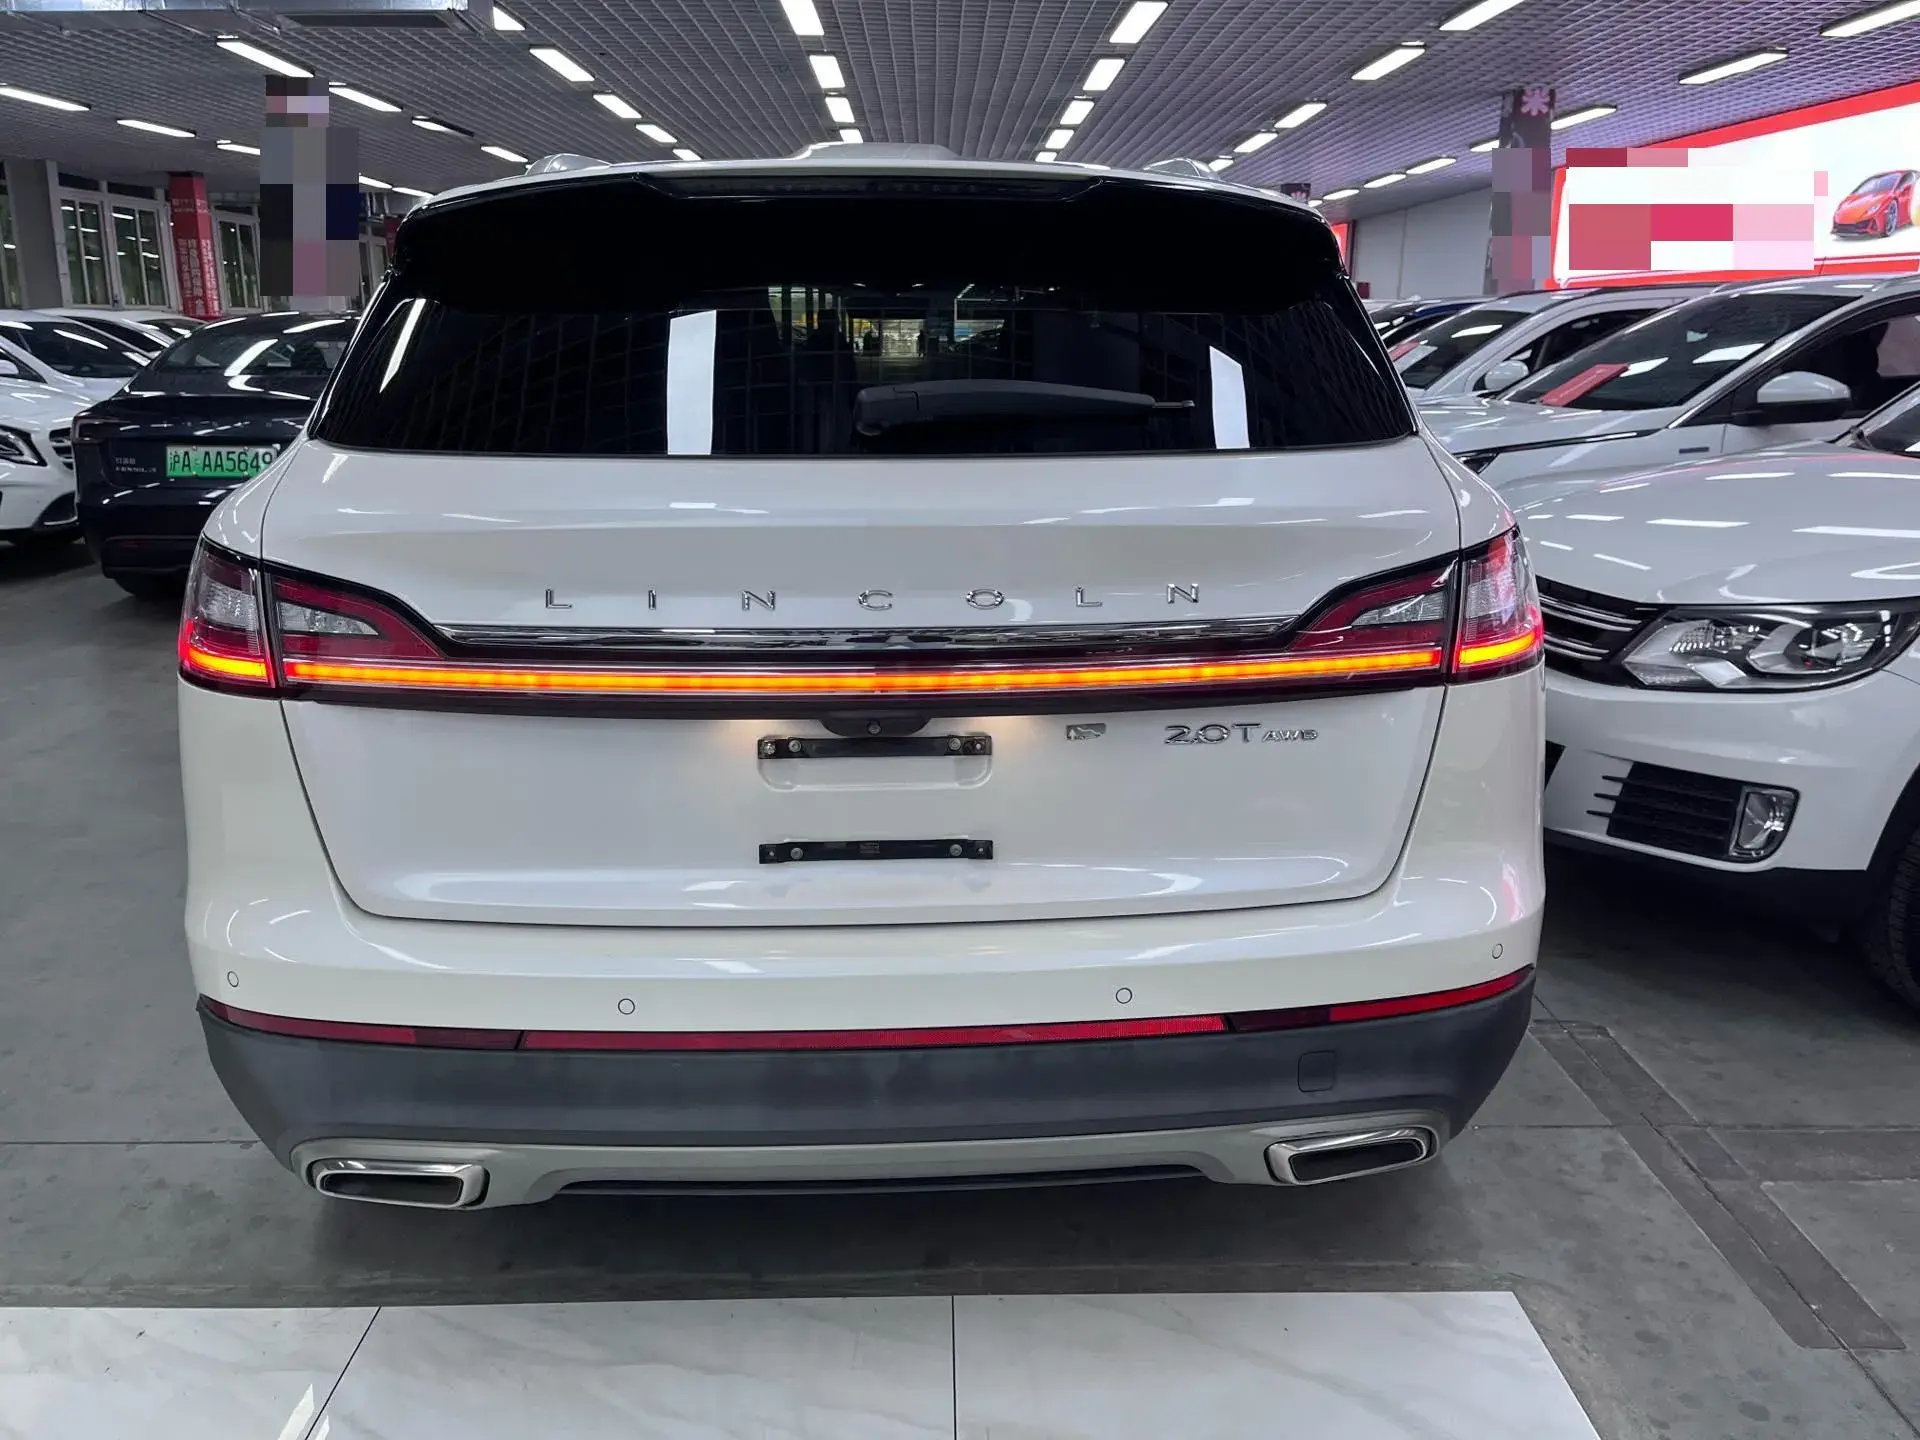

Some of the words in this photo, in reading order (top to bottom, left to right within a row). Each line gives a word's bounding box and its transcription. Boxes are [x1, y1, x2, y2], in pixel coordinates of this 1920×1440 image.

[545, 583, 1199, 611] LINCOLN
[1163, 722, 1262, 746] 2.0T
[1261, 729, 1319, 743] AWD
